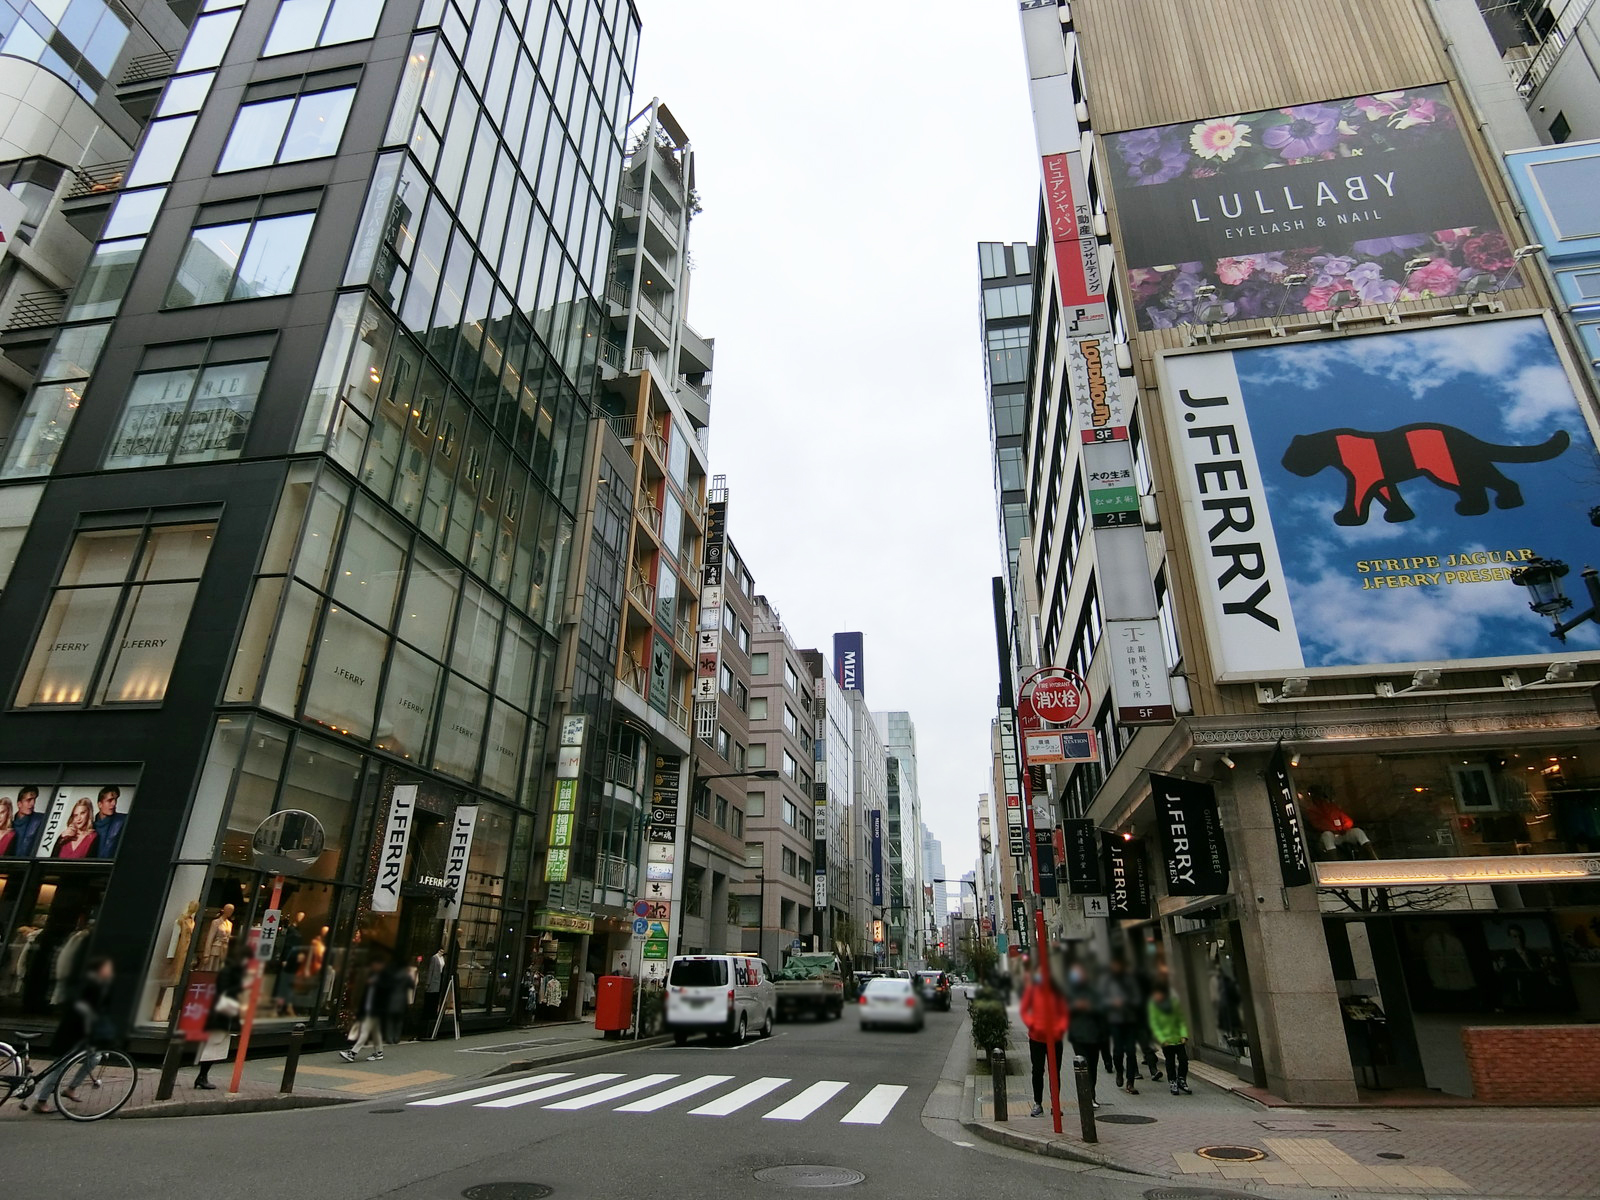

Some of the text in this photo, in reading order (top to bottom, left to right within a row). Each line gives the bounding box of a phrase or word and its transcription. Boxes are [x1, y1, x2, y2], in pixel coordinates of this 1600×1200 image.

[1049, 158, 1072, 237] ピュアジャパン
[1191, 171, 1397, 223] LULLABY
[1225, 209, 1382, 240] EYELASH & NAIL
[1096, 429, 1112, 439] 3F
[1089, 469, 1131, 481] 犬の生活
[1107, 512, 1127, 523] 2F
[1179, 388, 1281, 633] J.FERRY
[1356, 547, 1534, 574] STRIPE JAGUAR
[1361, 572, 1441, 590] J.FERRY
[48, 643, 90, 651] J.FERRY
[122, 639, 167, 649] J.FERRY
[333, 666, 365, 686] J.FERRY
[1126, 646, 1141, 699] 法律事務所
[1137, 645, 1152, 698] 銀座さいとう
[398, 698, 425, 714] J.FERRY
[1035, 689, 1077, 709] 消火栓
[1139, 708, 1153, 718] 5F
[451, 723, 473, 738] J.FERRY
[495, 745, 514, 757] J.FERRY
[42, 792, 67, 852] J.FERRY
[1277, 771, 1306, 868] J.FERRY
[380, 799, 410, 896] J.FERRY
[1165, 793, 1196, 885] J.FERRY
[1203, 809, 1222, 874] GINZA J.STREET
[444, 818, 471, 909] J.FERRY
[1168, 859, 1179, 884] MEN
[418, 875, 448, 888] J.FERRY
[1111, 846, 1128, 912] J.FERRY
[635, 922, 643, 932] P
[733, 957, 759, 985] FedEx
